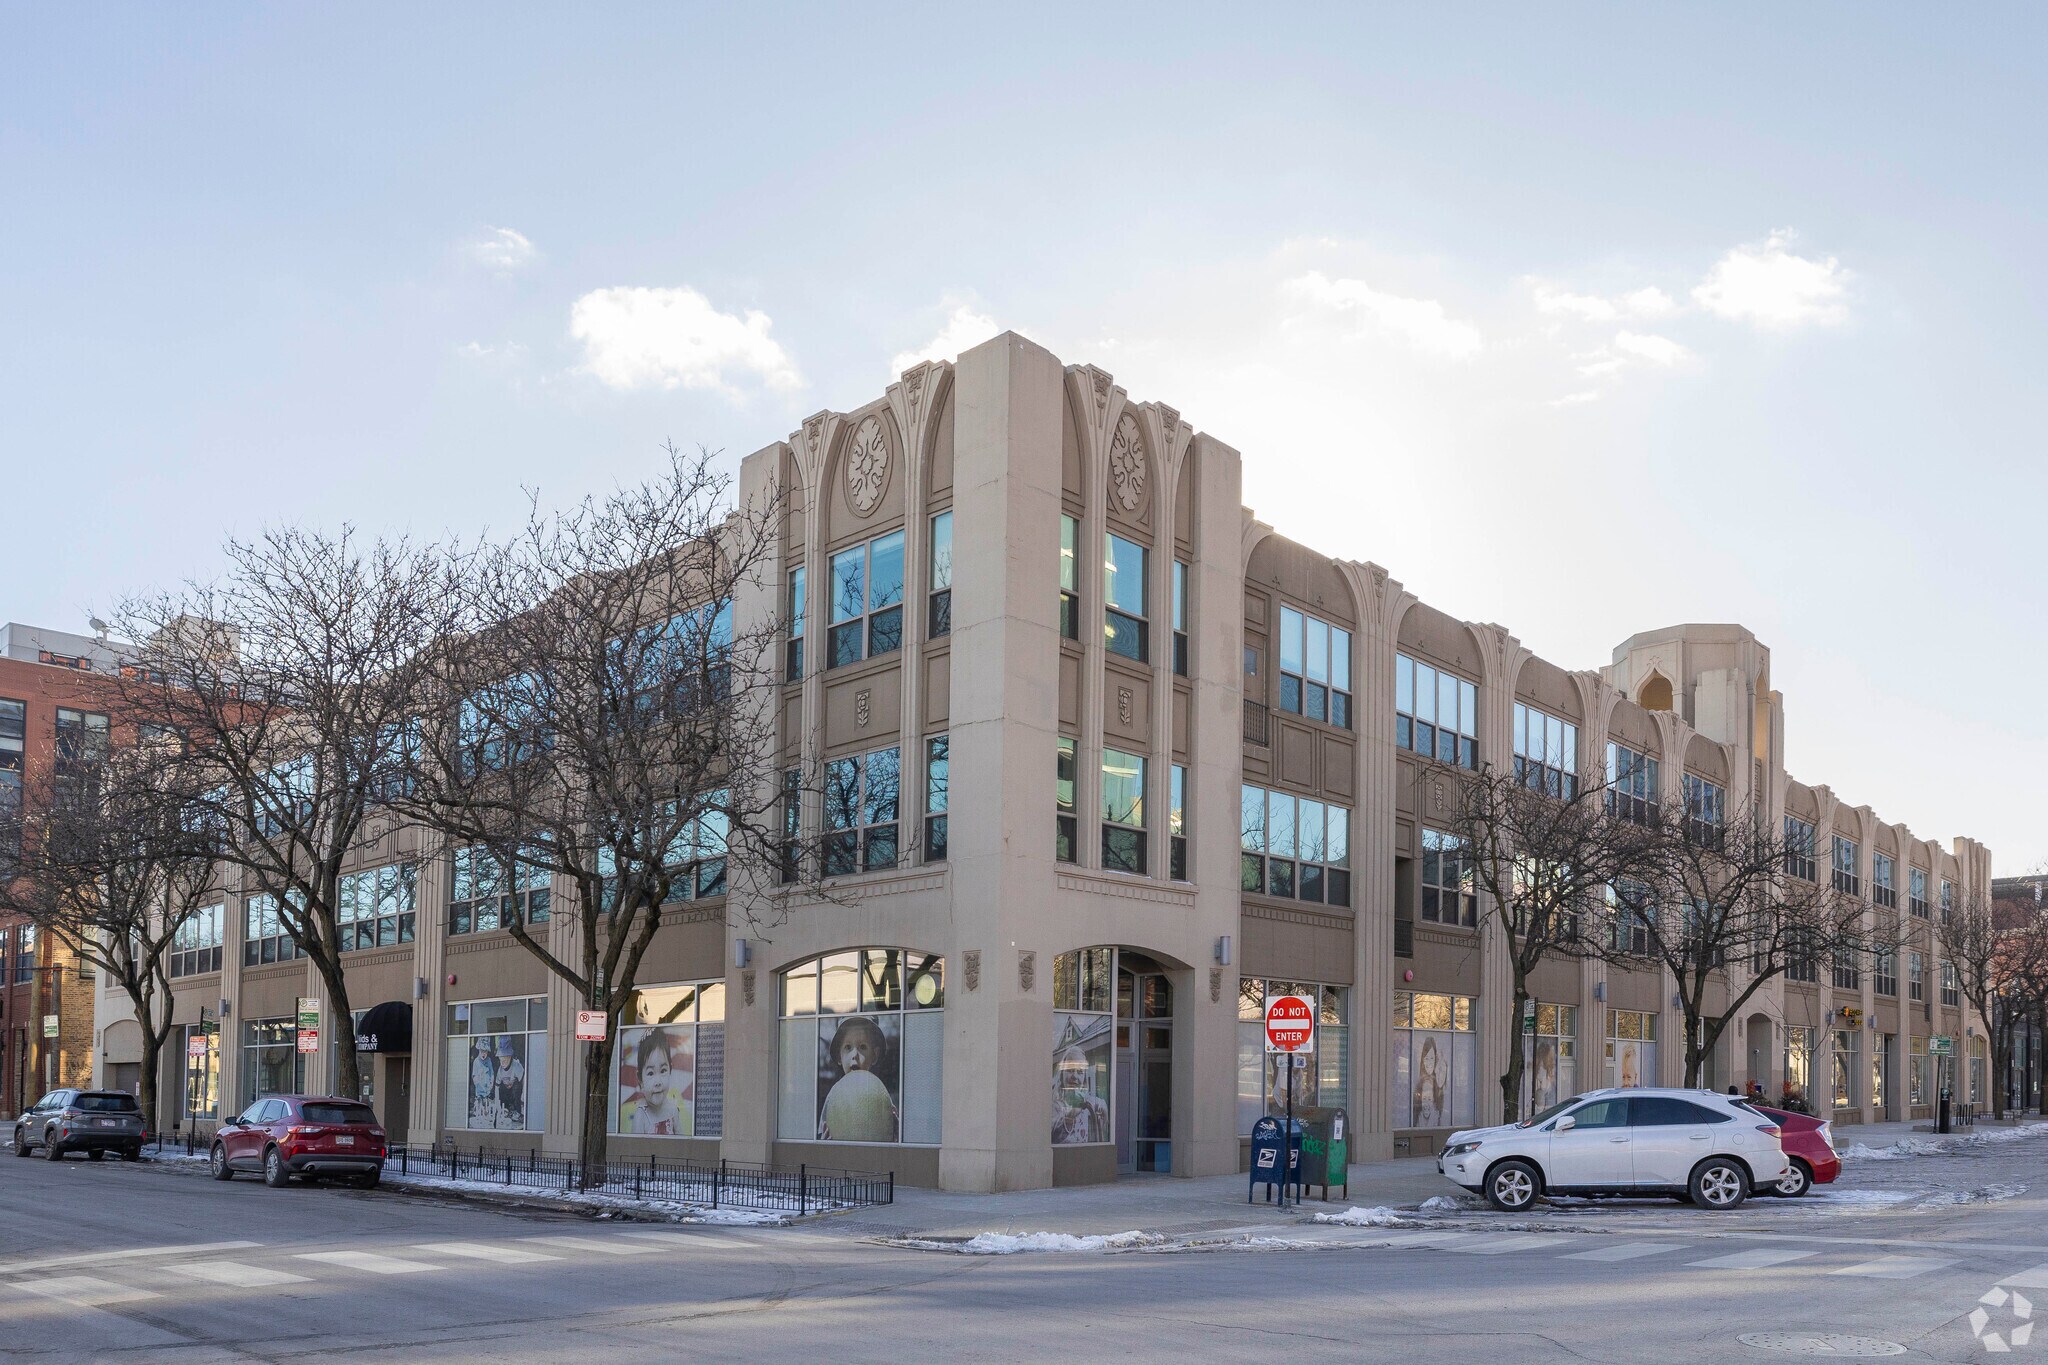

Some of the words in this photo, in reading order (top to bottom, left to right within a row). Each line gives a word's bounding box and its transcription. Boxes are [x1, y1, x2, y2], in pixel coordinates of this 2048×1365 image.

[1272, 1007, 1284, 1017] DO
[1289, 1007, 1306, 1017] NOT
[358, 1034, 370, 1043] ids
[371, 1034, 378, 1042] &
[1276, 1032, 1302, 1041] ENTER
